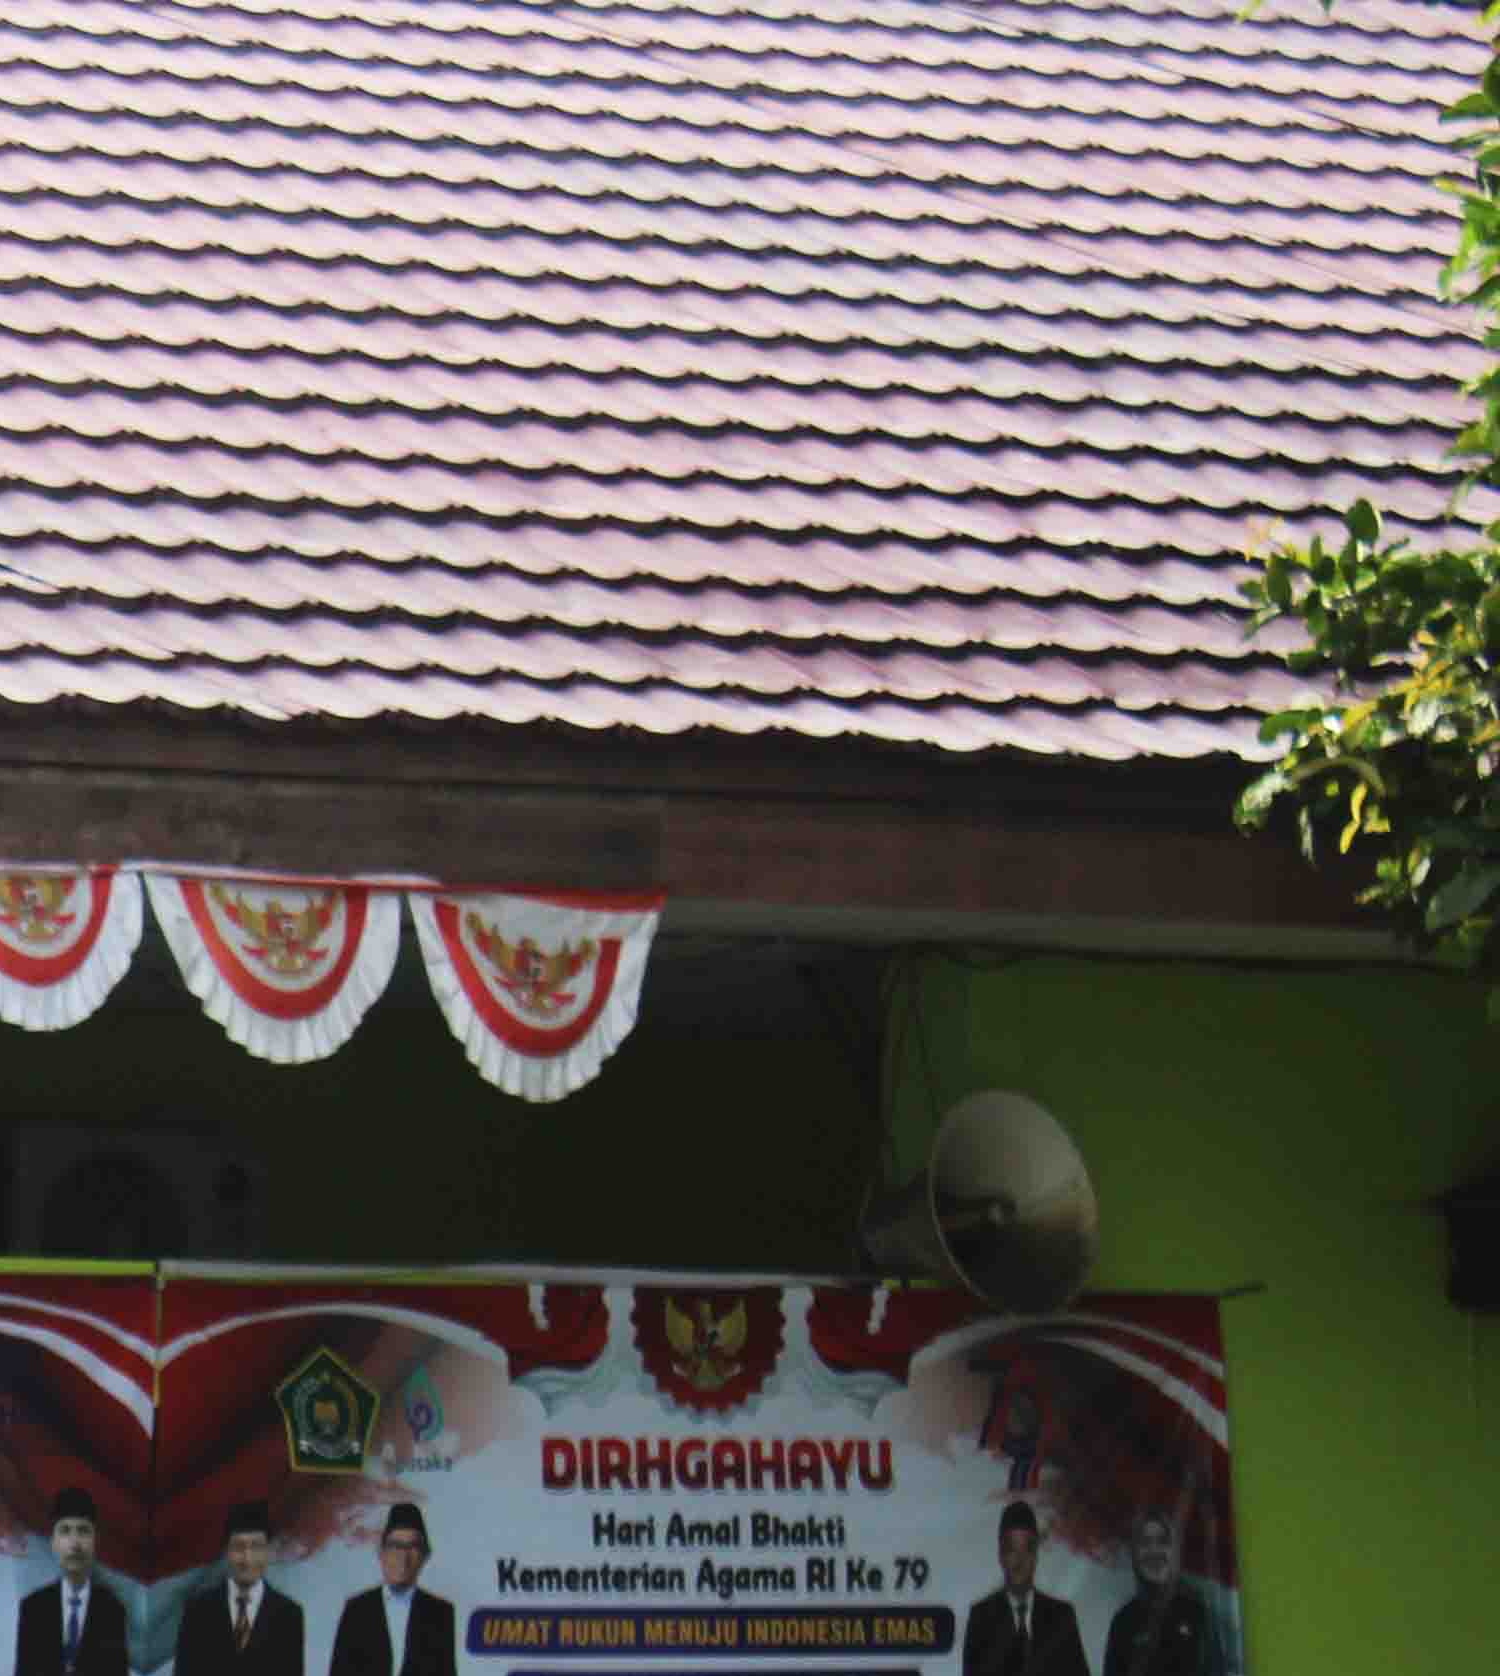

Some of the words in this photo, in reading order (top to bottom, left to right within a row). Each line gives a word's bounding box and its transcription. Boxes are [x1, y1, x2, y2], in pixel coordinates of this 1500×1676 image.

[539, 1436, 894, 1491] DIRHGAHAYU
[592, 1512, 656, 1547] Hari
[666, 1512, 740, 1547] Amal
[751, 1512, 846, 1547] Bhakti
[496, 1557, 686, 1593] Kementerian
[696, 1556, 797, 1600] Agama
[806, 1557, 836, 1592] RI
[846, 1557, 883, 1592] Ke
[894, 1556, 930, 1591] 79
[483, 1617, 551, 1647] UMAT
[558, 1617, 637, 1647] RUKUN
[643, 1617, 739, 1647] MENUJU
[746, 1617, 866, 1647] INDONESIA
[873, 1616, 936, 1646] EMAS
